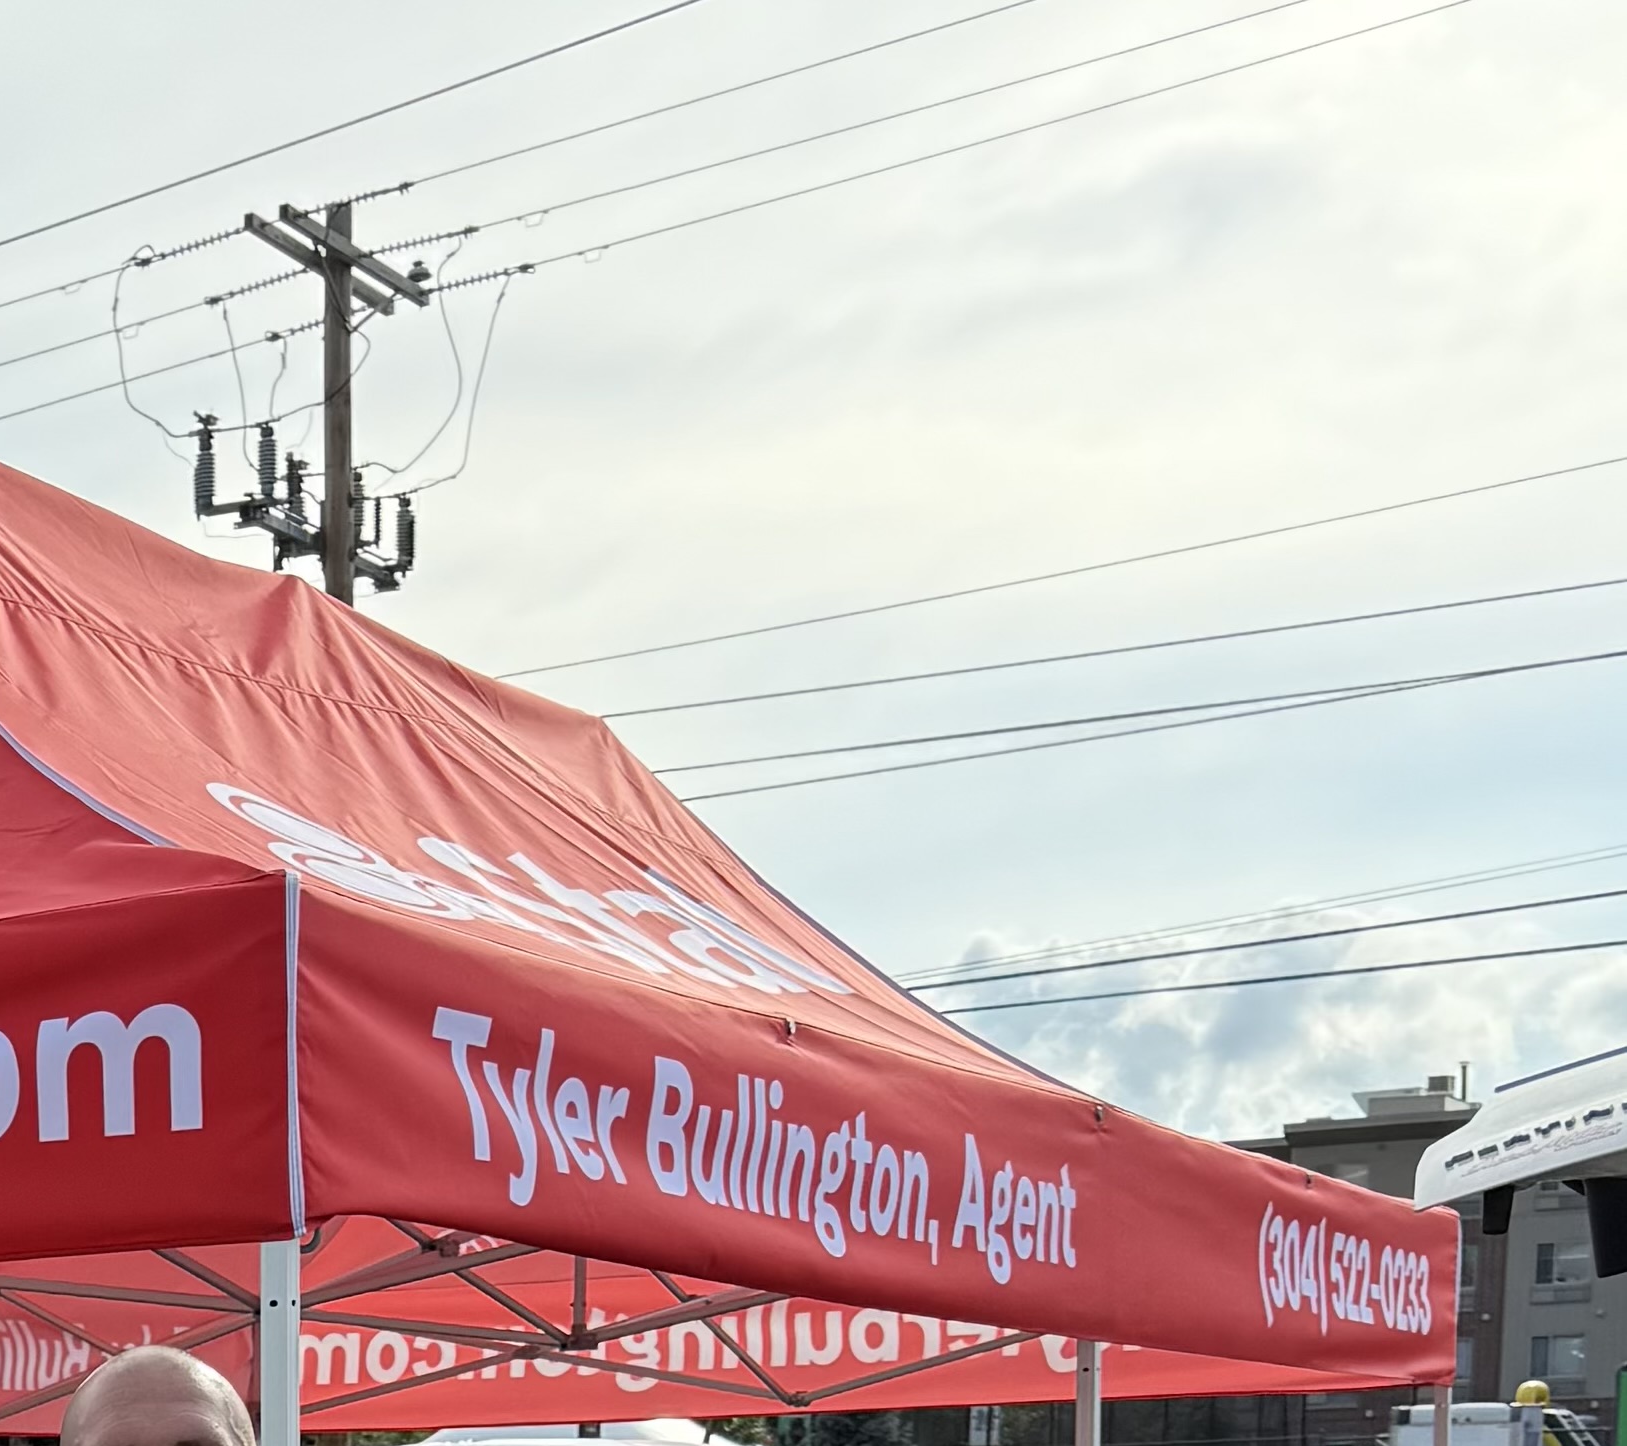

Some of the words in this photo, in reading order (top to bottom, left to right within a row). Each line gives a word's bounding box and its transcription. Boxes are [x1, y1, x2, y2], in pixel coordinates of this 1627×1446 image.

[433, 1006, 630, 1206] Tyler
[646, 1055, 940, 1265] Bullington,
[952, 1132, 1076, 1285] Agent
[1259, 1201, 1328, 1336] (304)
[1330, 1231, 1434, 1336] 522-0233
